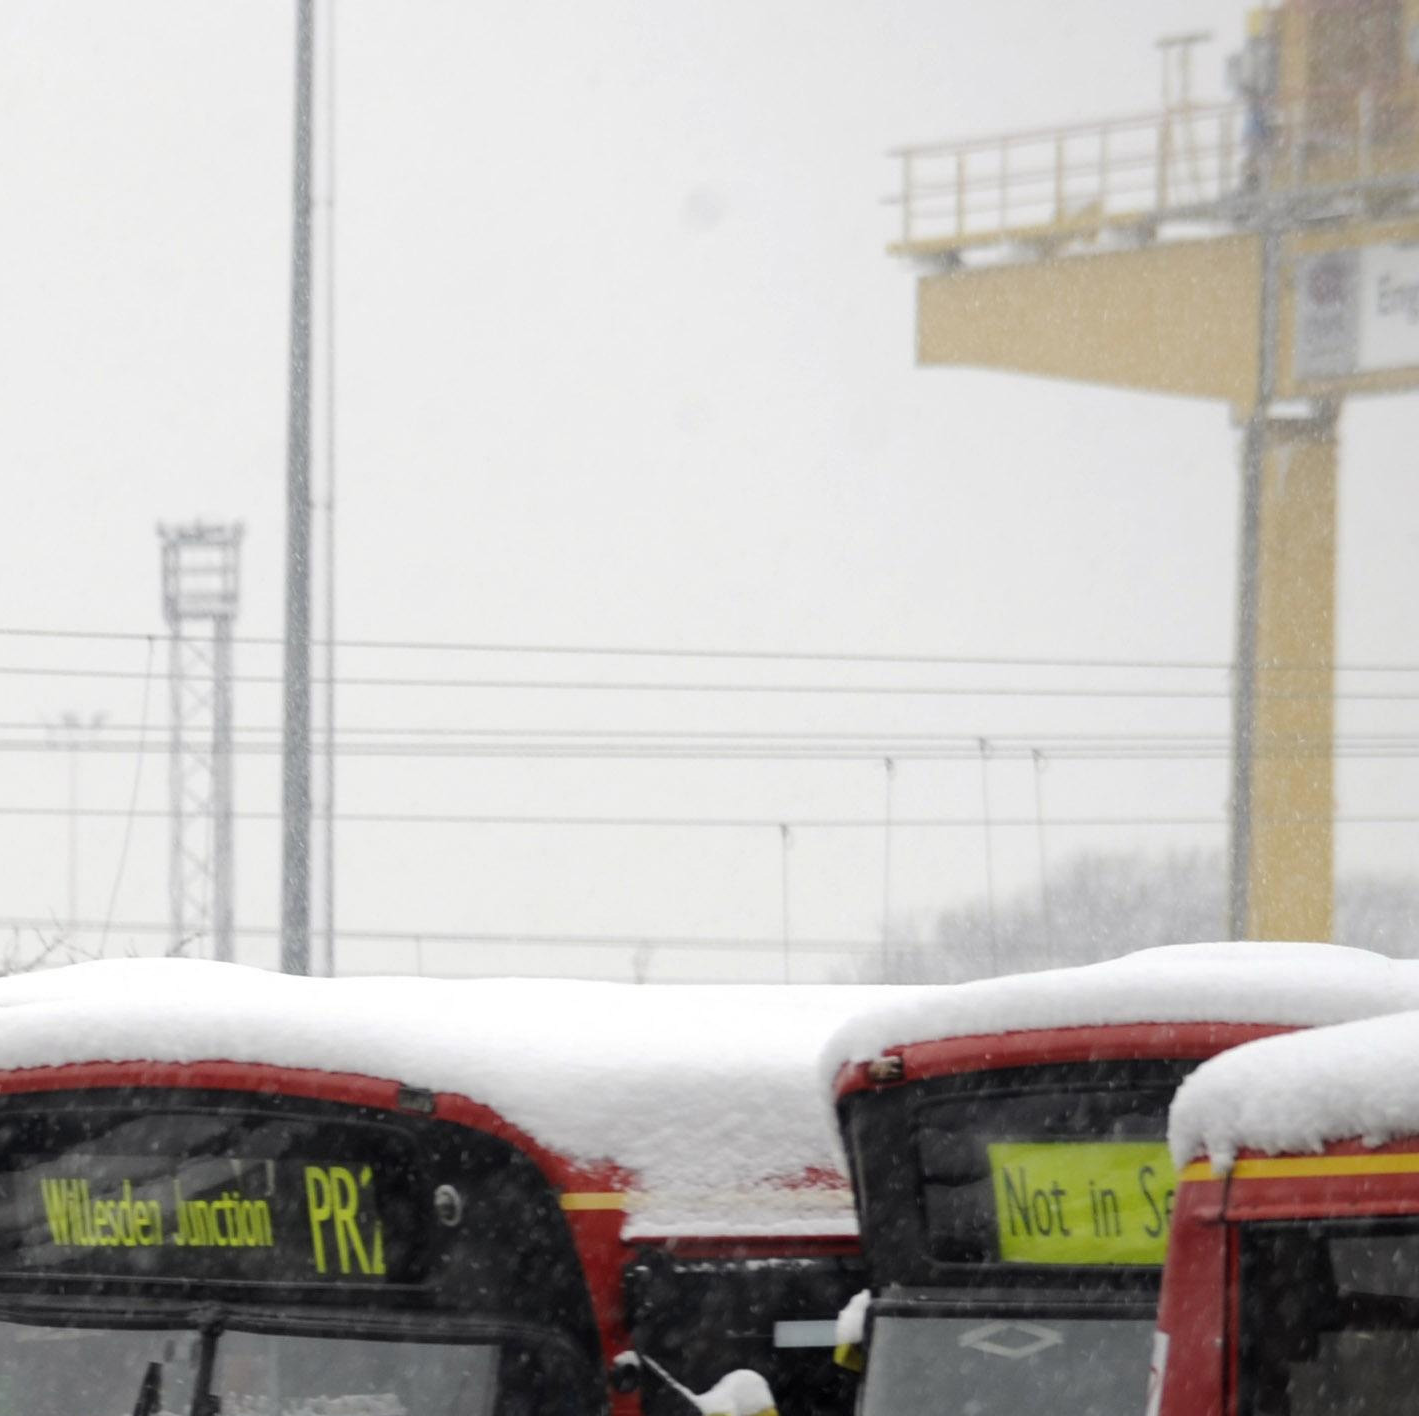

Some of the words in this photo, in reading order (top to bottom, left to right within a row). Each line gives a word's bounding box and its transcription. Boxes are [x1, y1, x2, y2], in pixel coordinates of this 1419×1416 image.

[40, 1177, 163, 1247] Willesden
[172, 1178, 273, 1247] Junction
[1002, 1164, 1070, 1237] Not
[1088, 1179, 1121, 1237] in
